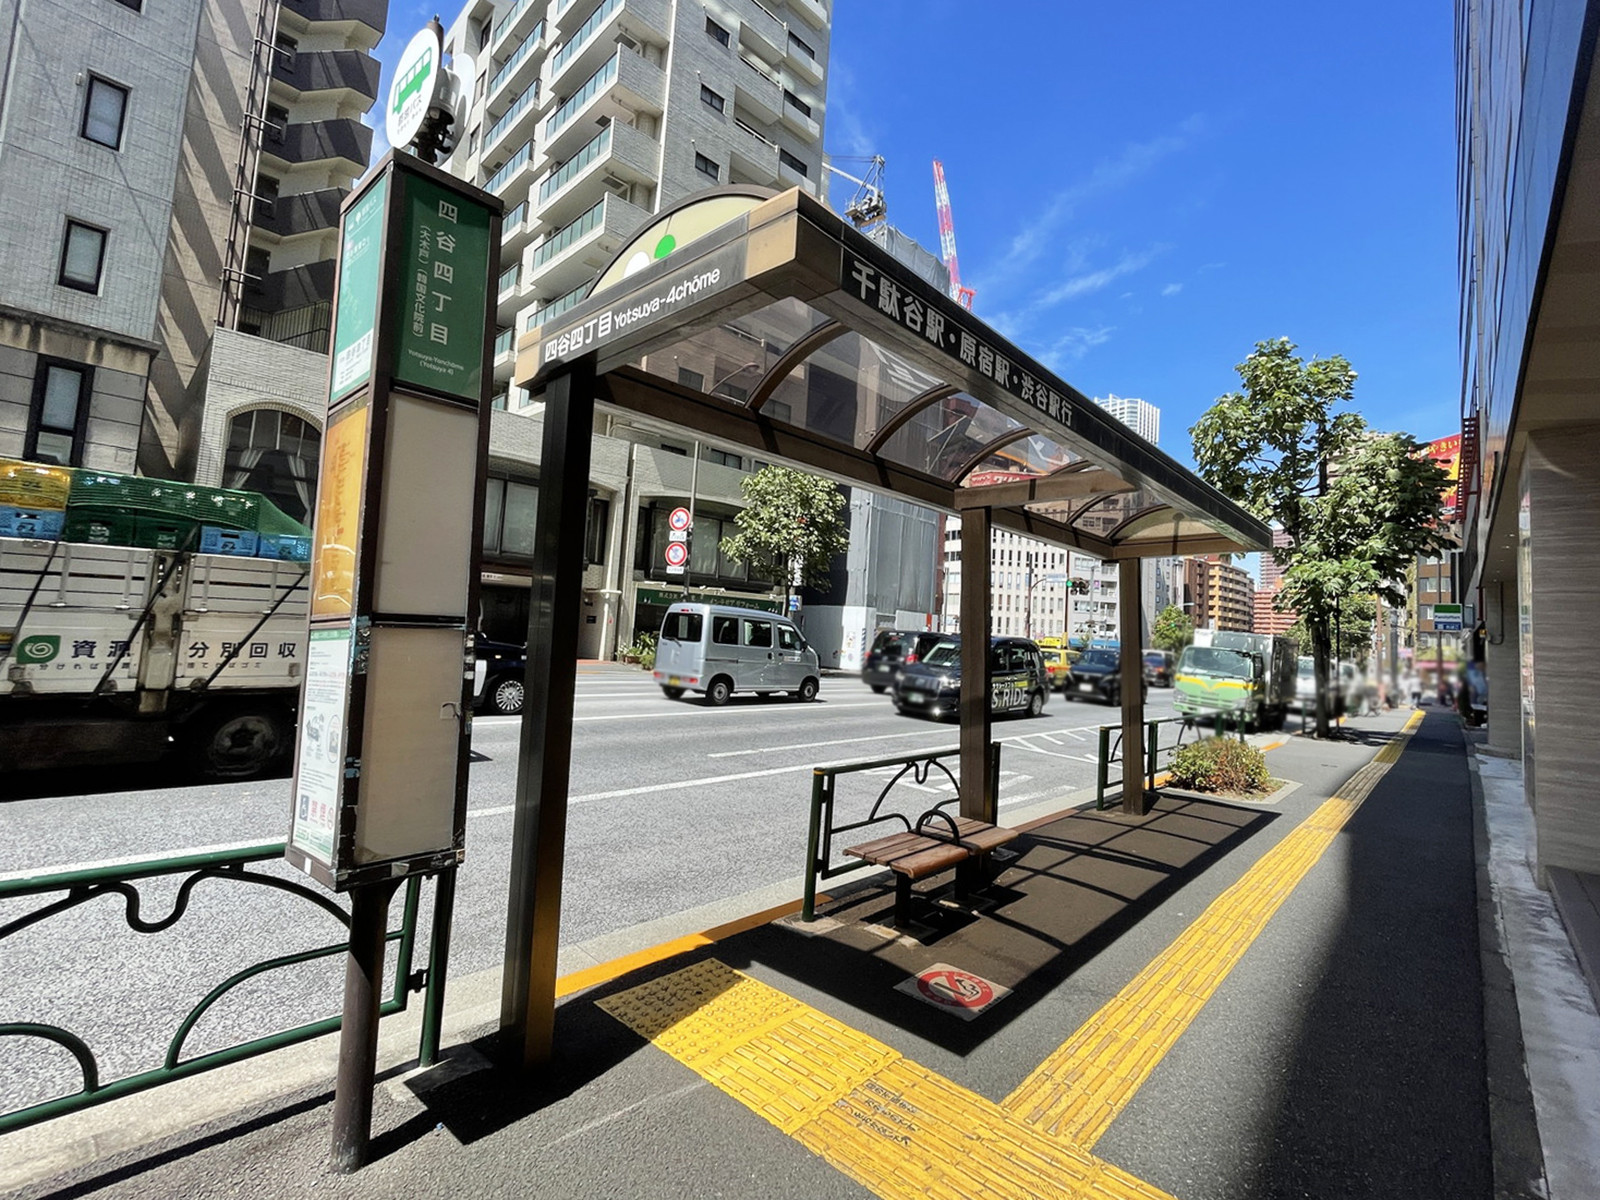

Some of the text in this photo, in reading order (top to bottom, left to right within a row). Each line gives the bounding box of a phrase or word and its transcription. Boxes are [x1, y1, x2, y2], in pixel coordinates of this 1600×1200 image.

[430, 200, 458, 345] 四谷四丁目
[545, 268, 720, 362] 四谷四丁目 Yotsuya-4chōme
